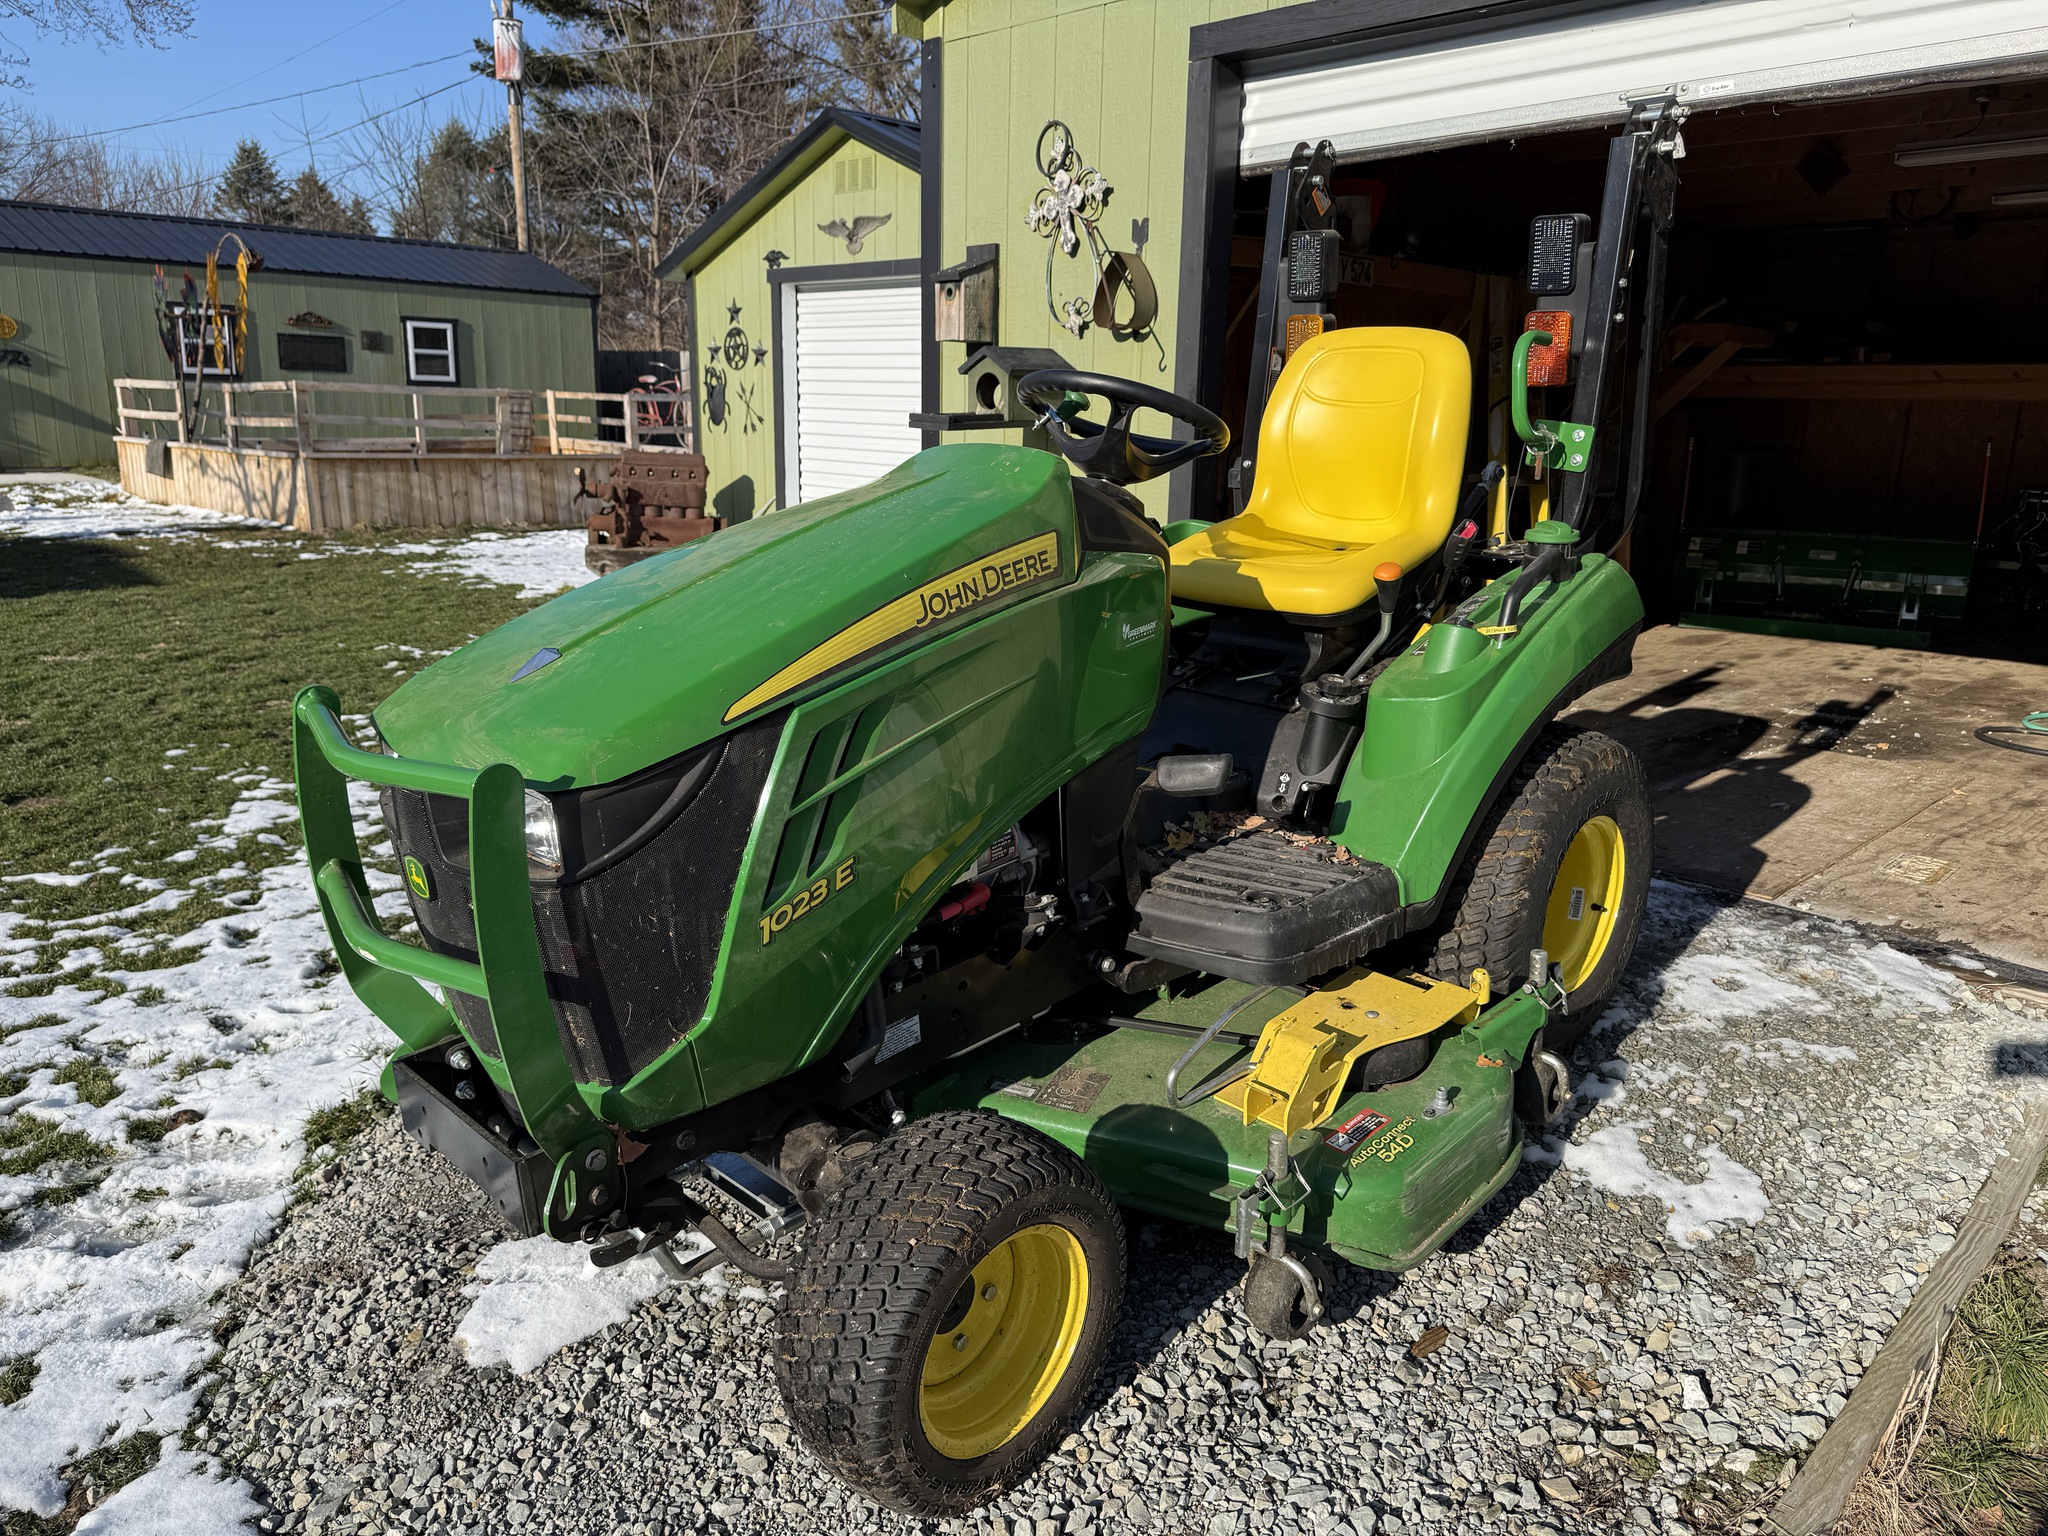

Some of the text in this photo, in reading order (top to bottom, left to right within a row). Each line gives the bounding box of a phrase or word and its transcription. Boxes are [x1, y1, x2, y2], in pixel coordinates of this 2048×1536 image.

[916, 550, 1053, 626] JOHN DEERE
[759, 857, 855, 946] 1023 E
[1350, 1115, 1417, 1168] AutoConnect
[1376, 1133, 1414, 1163] 54D
[1016, 1203, 1096, 1229] CARLISLE
